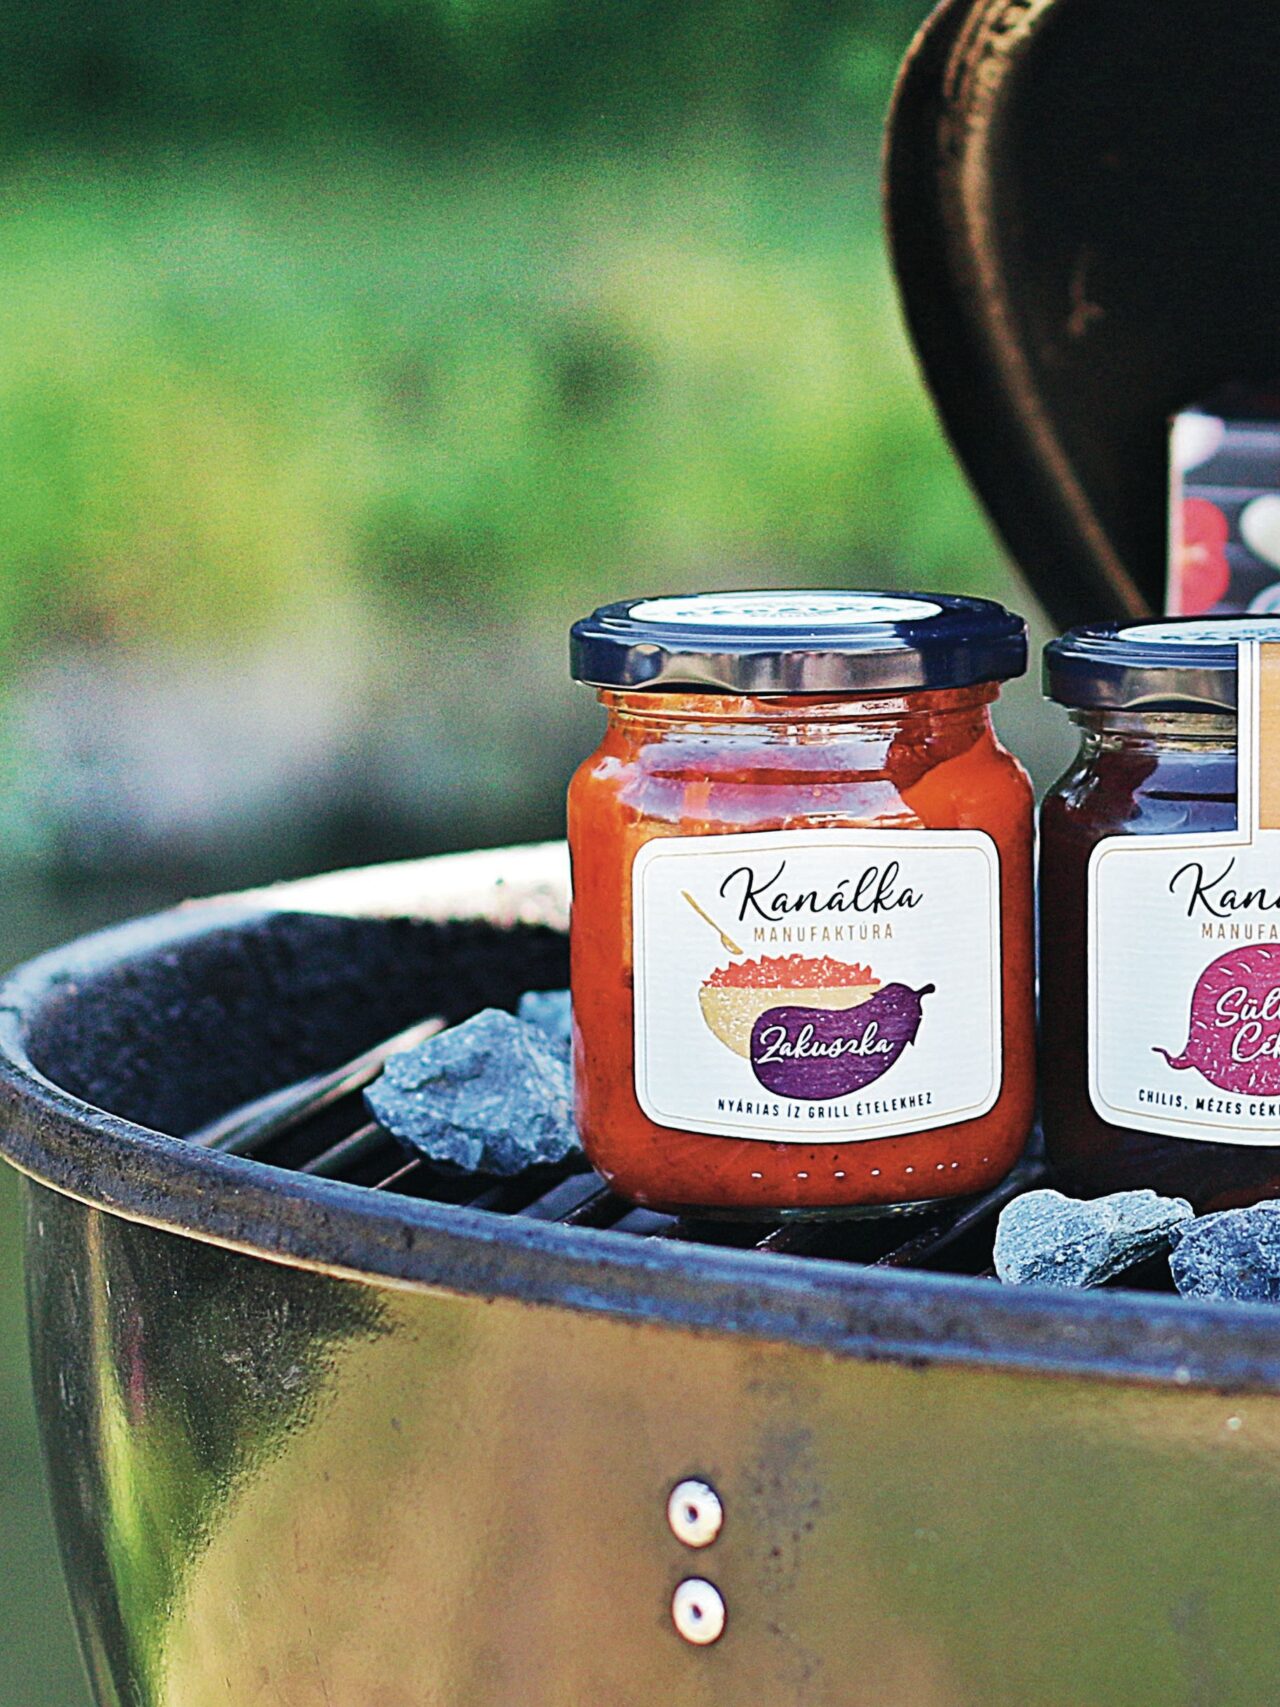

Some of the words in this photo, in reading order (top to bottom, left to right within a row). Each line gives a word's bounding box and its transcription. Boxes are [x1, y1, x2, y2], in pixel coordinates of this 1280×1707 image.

[720, 860, 923, 922] Kanálka
[753, 922, 894, 943] MANUFAKTÚRA
[756, 1021, 895, 1065] Zakuszka
[718, 1098, 780, 1117] NYÁRIAS
[787, 1103, 800, 1118] ÍZ
[808, 1106, 849, 1119] GRILL
[857, 1092, 932, 1116] ÉTELEKHEZ
[1196, 1097, 1242, 1115] MÉZES
